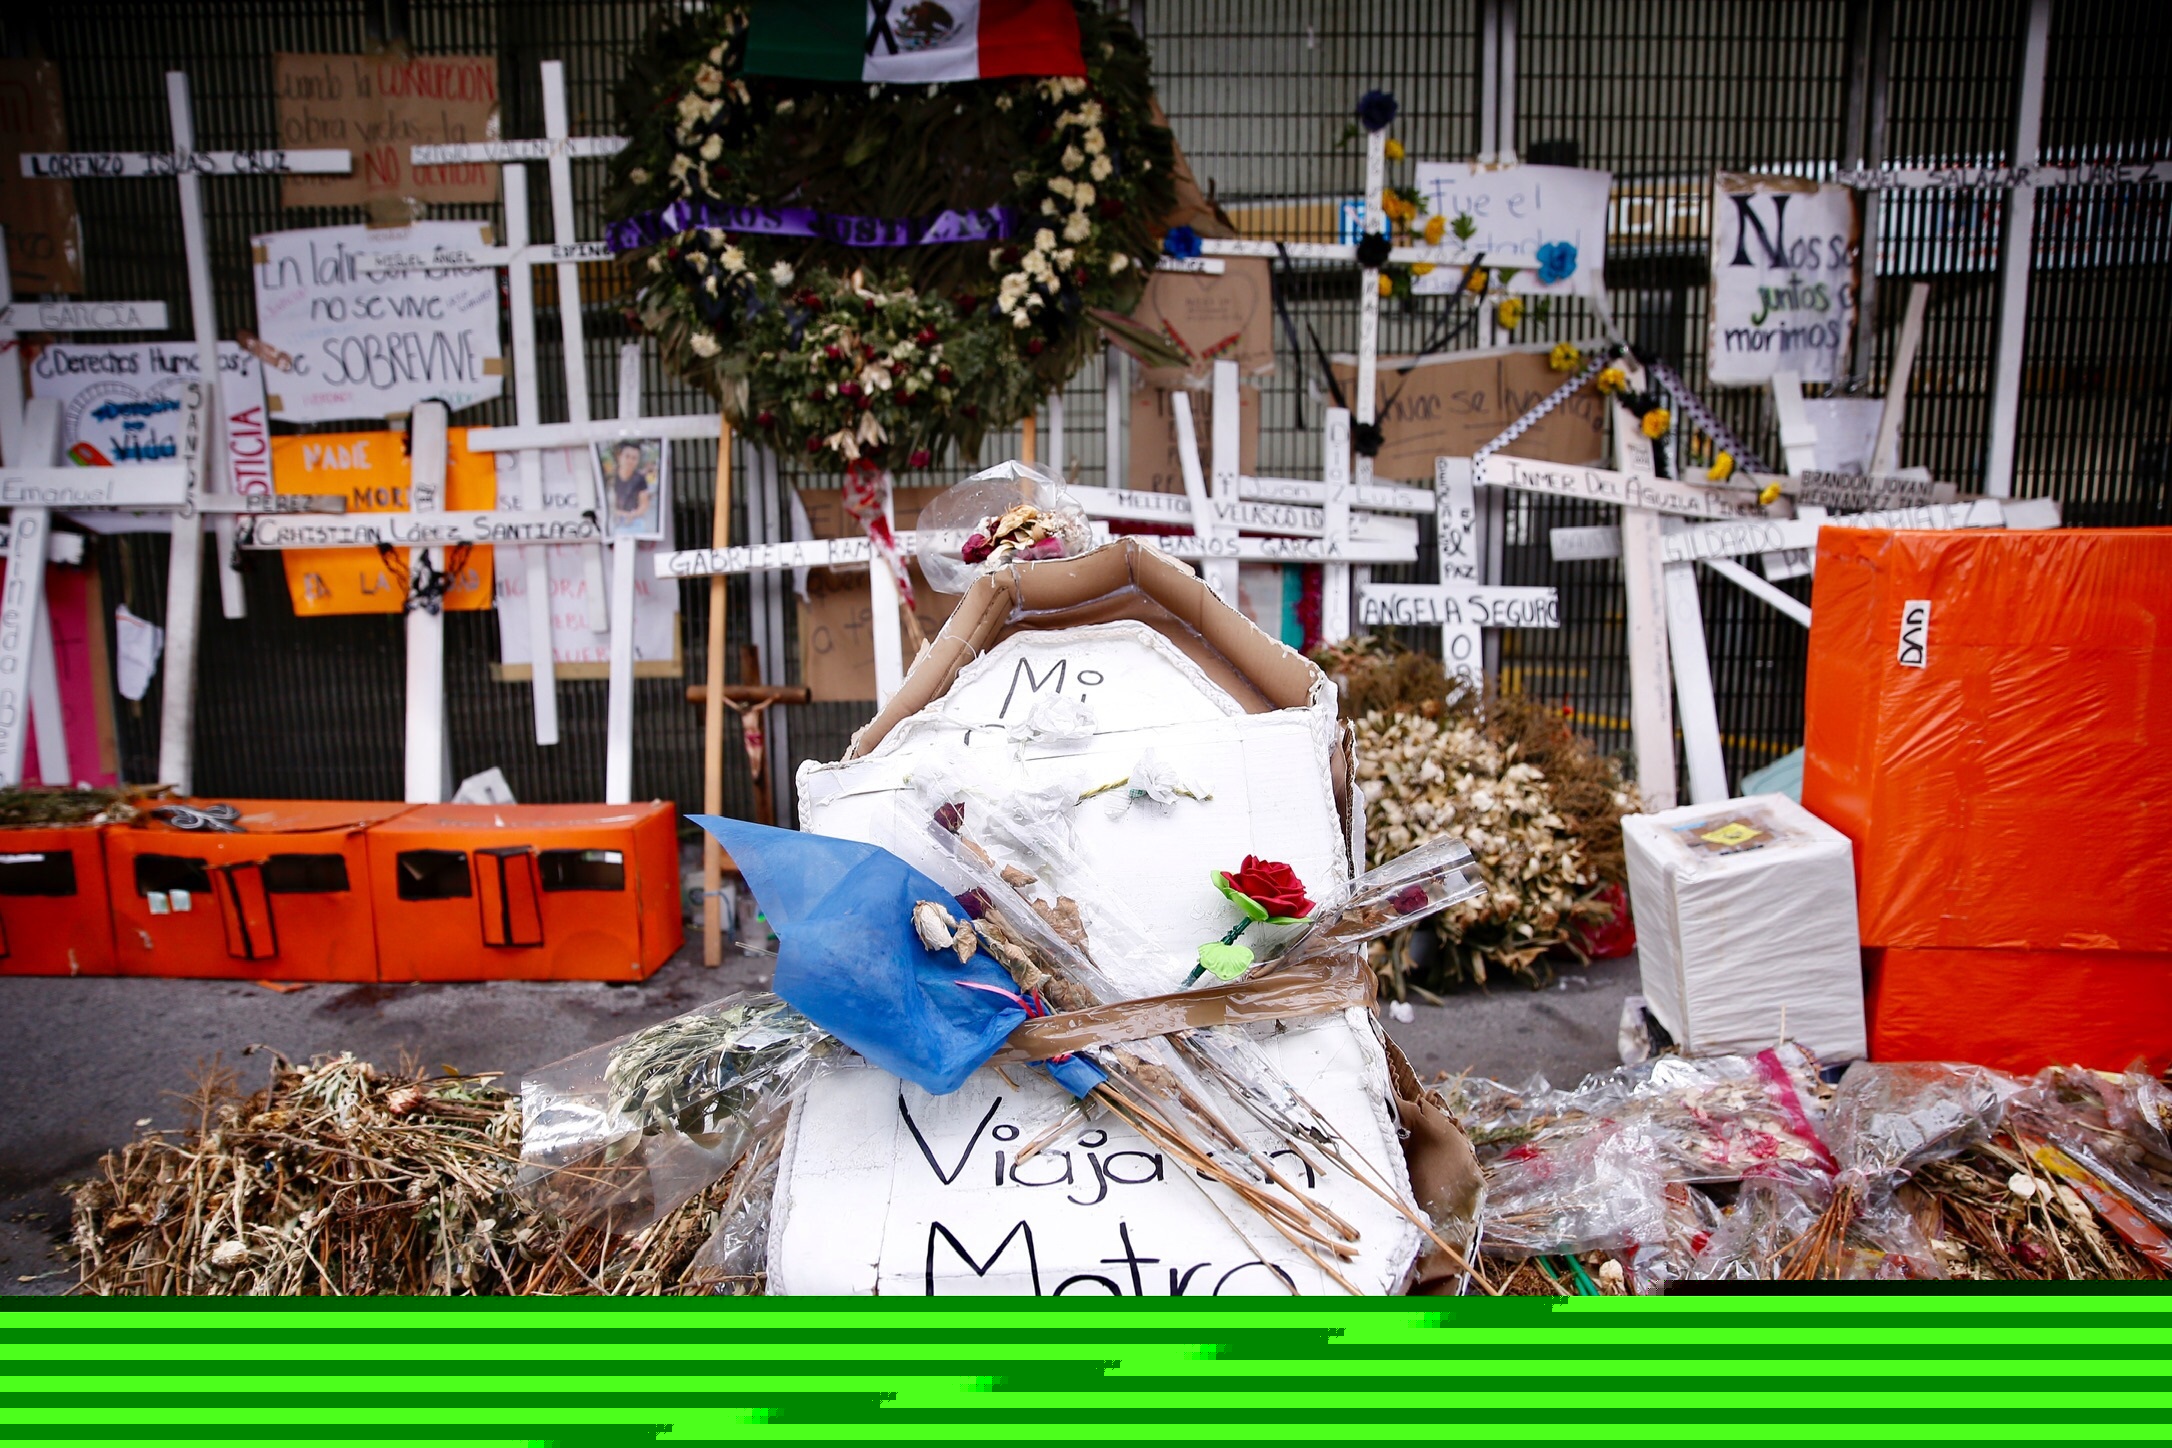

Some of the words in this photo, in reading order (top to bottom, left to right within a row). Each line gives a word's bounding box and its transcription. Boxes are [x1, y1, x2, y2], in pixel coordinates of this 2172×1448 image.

[32, 156, 123, 177] LORENZO
[232, 152, 291, 174] CRUZ
[364, 145, 399, 186] NO
[1926, 166, 2030, 189] SALAZAR
[1727, 192, 1822, 271] Nos
[1750, 272, 1831, 326] juntos
[1724, 320, 1841, 354] morimos
[2, 476, 115, 502] Emanuel
[668, 540, 806, 576] GABRIELA
